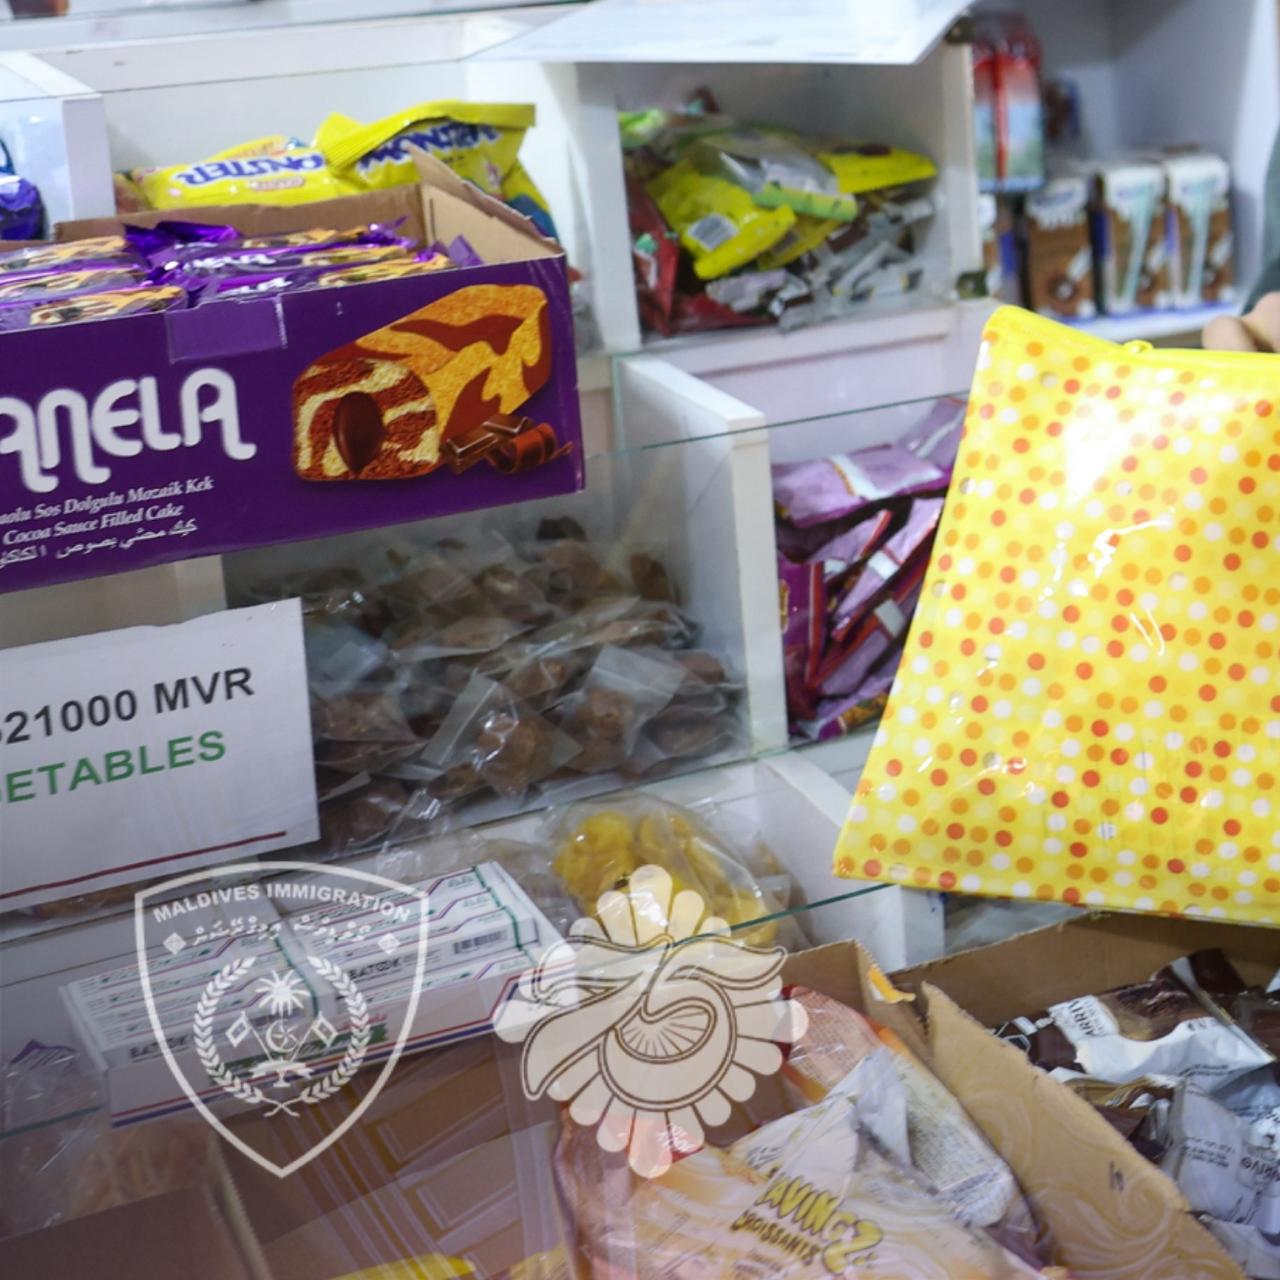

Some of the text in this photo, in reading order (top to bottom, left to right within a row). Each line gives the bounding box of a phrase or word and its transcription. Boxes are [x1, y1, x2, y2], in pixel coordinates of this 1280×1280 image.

[176, 150, 326, 186] ONSTER
[33, 501, 62, 520] Sos
[63, 490, 125, 515] Dolgulu
[126, 481, 184, 504] Mozaik
[185, 475, 215, 494] Kek
[3, 503, 184, 545] Cocoa Sauce Filled Cake
[0, 666, 256, 746] 21000 MVR
[0, 730, 227, 804] ETABLES
